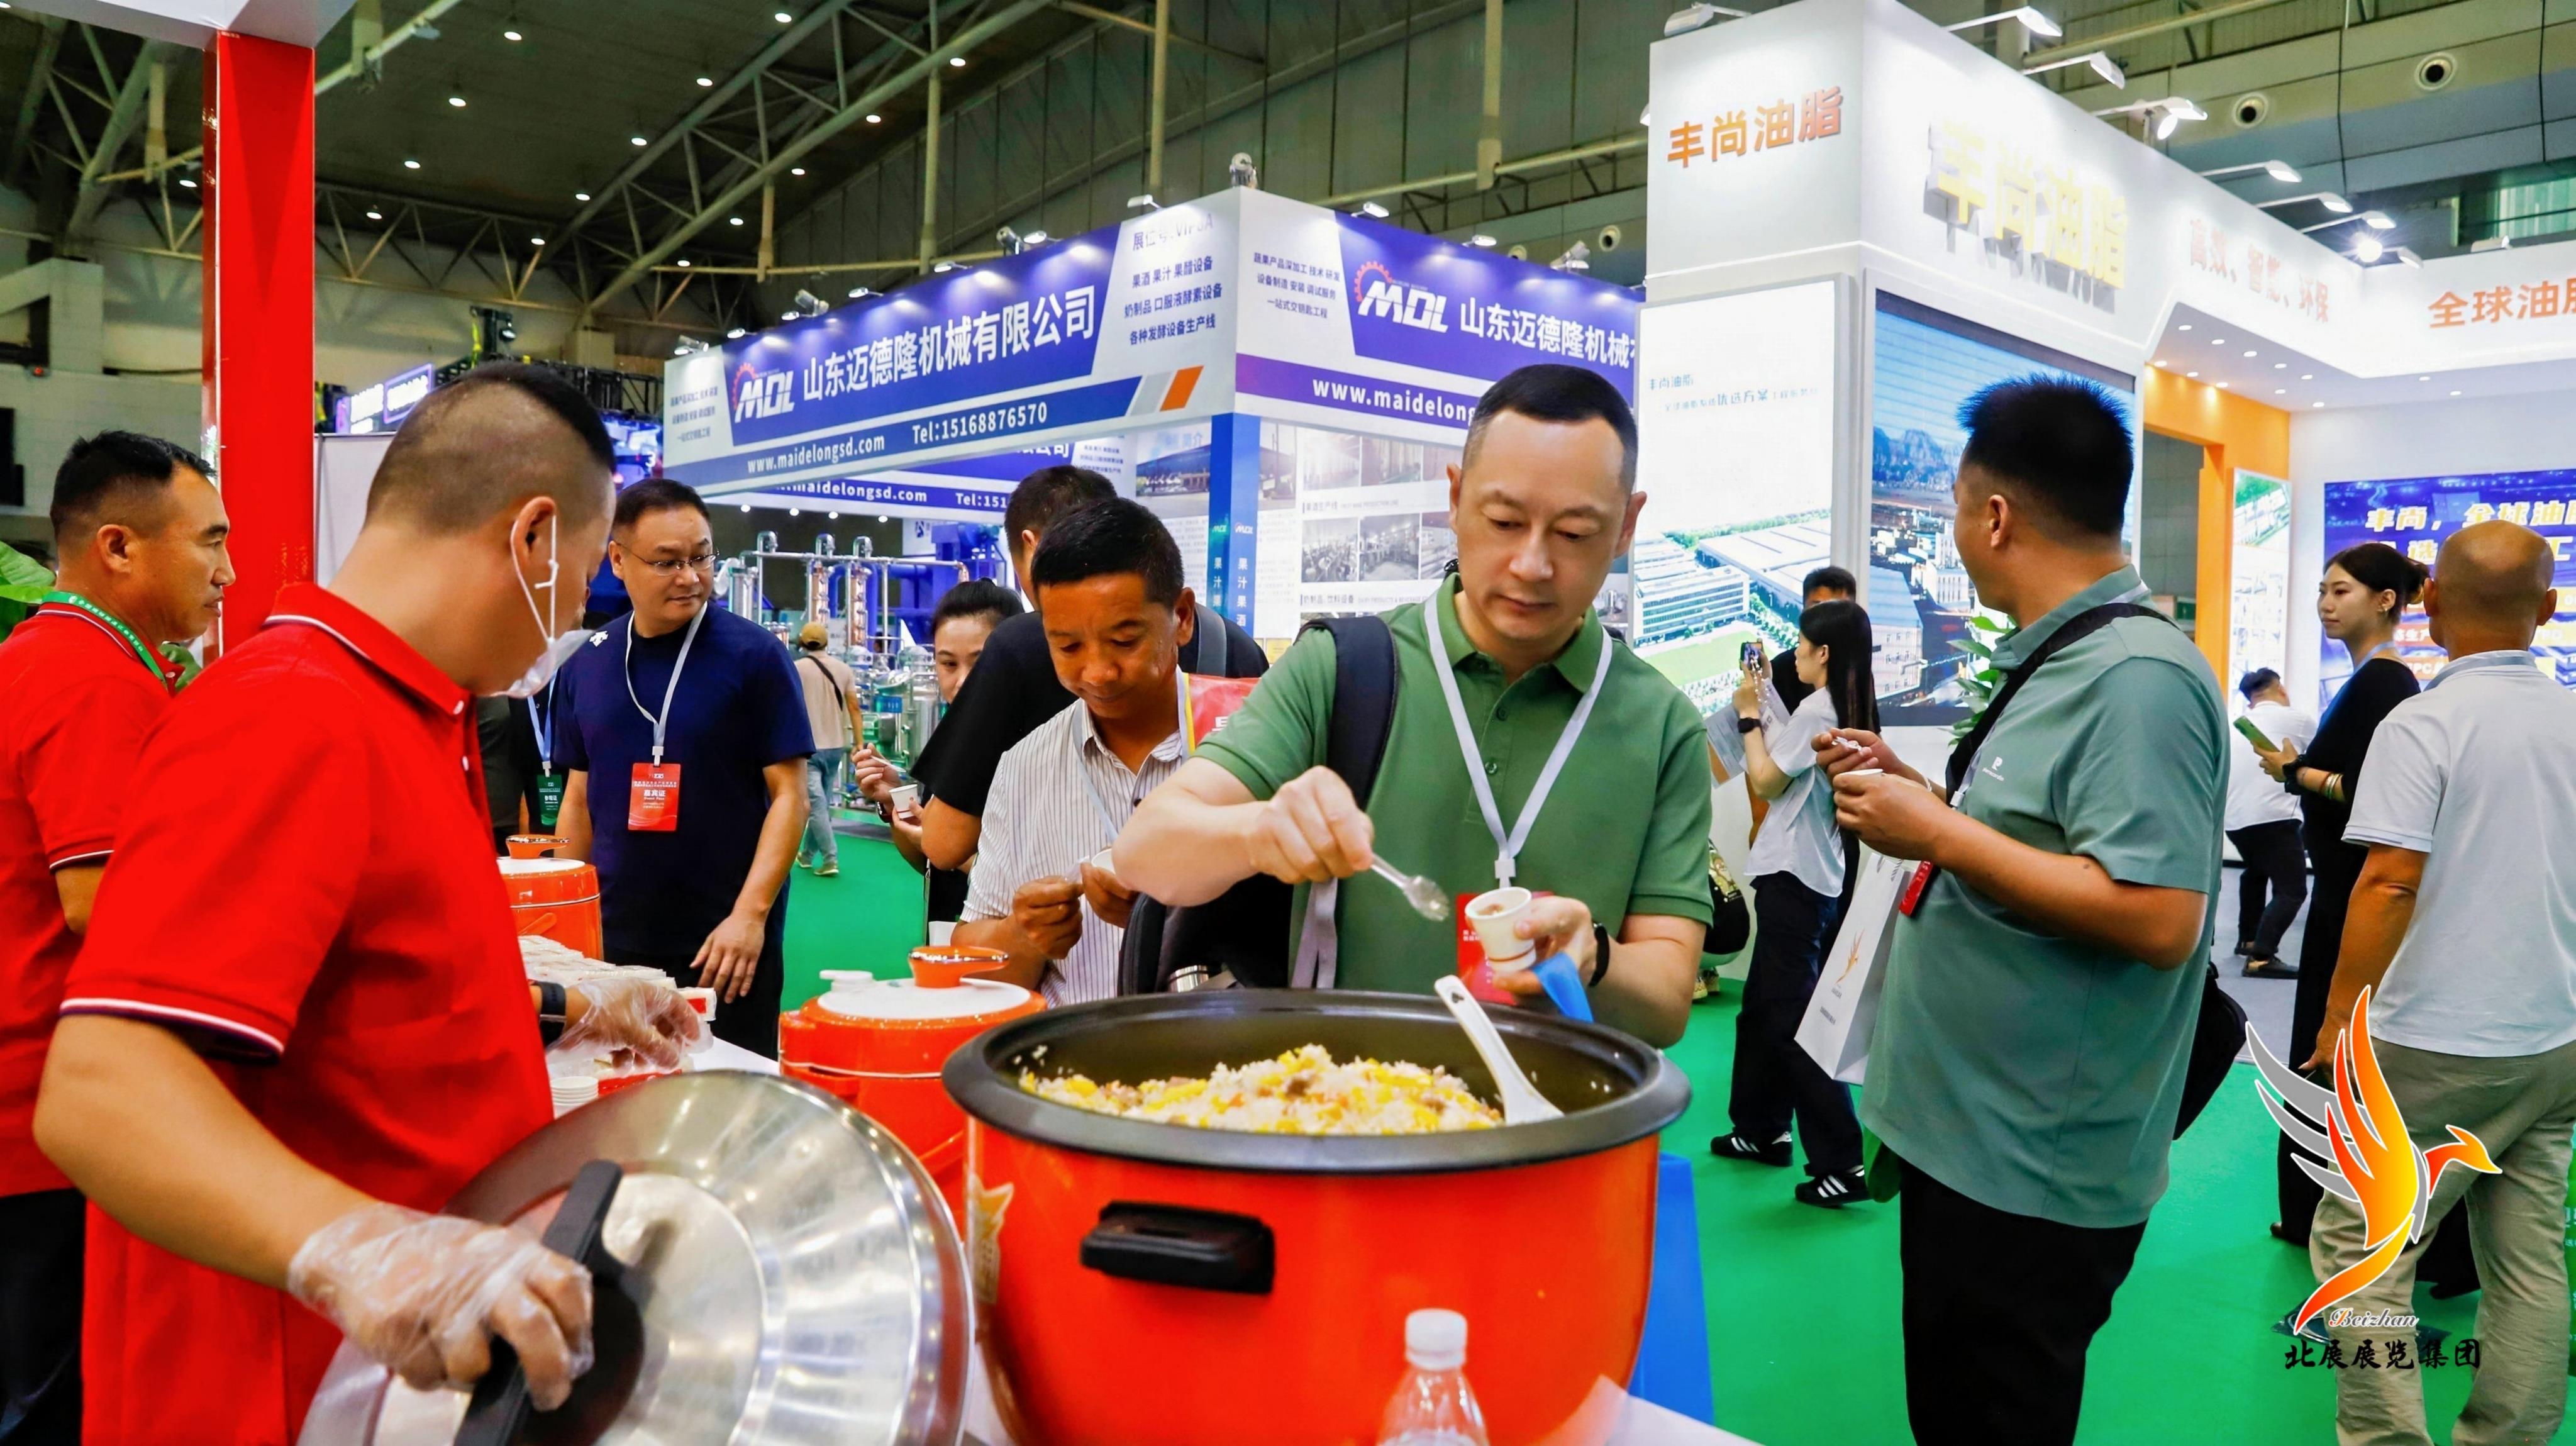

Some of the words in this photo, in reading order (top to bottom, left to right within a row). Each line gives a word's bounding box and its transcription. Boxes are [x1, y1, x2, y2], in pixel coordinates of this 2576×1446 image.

[1667, 86, 1843, 168] 丰尚油脂
[1931, 118, 2128, 289] 丰尚油脂
[1132, 272, 1150, 289] 果酒
[1153, 266, 1172, 284] 果汁
[1174, 255, 1213, 278] 果醋设备
[1257, 273, 1288, 289] 设备制造
[1290, 281, 1304, 293] 安装
[1124, 299, 1152, 318] 奶制品
[1154, 282, 1223, 311] 口服液酵素设备
[1358, 279, 1448, 333] MDL
[802, 285, 1095, 401] 山东迈德隆机械有限公司
[1130, 313, 1216, 345] 各种发酵设备生产线
[1460, 297, 1636, 369] 山东迈德隆机械
[734, 370, 796, 423] MDL
[912, 402, 1048, 445] Tel:15168876570
[747, 435, 886, 474] www.maidelongsd.com
